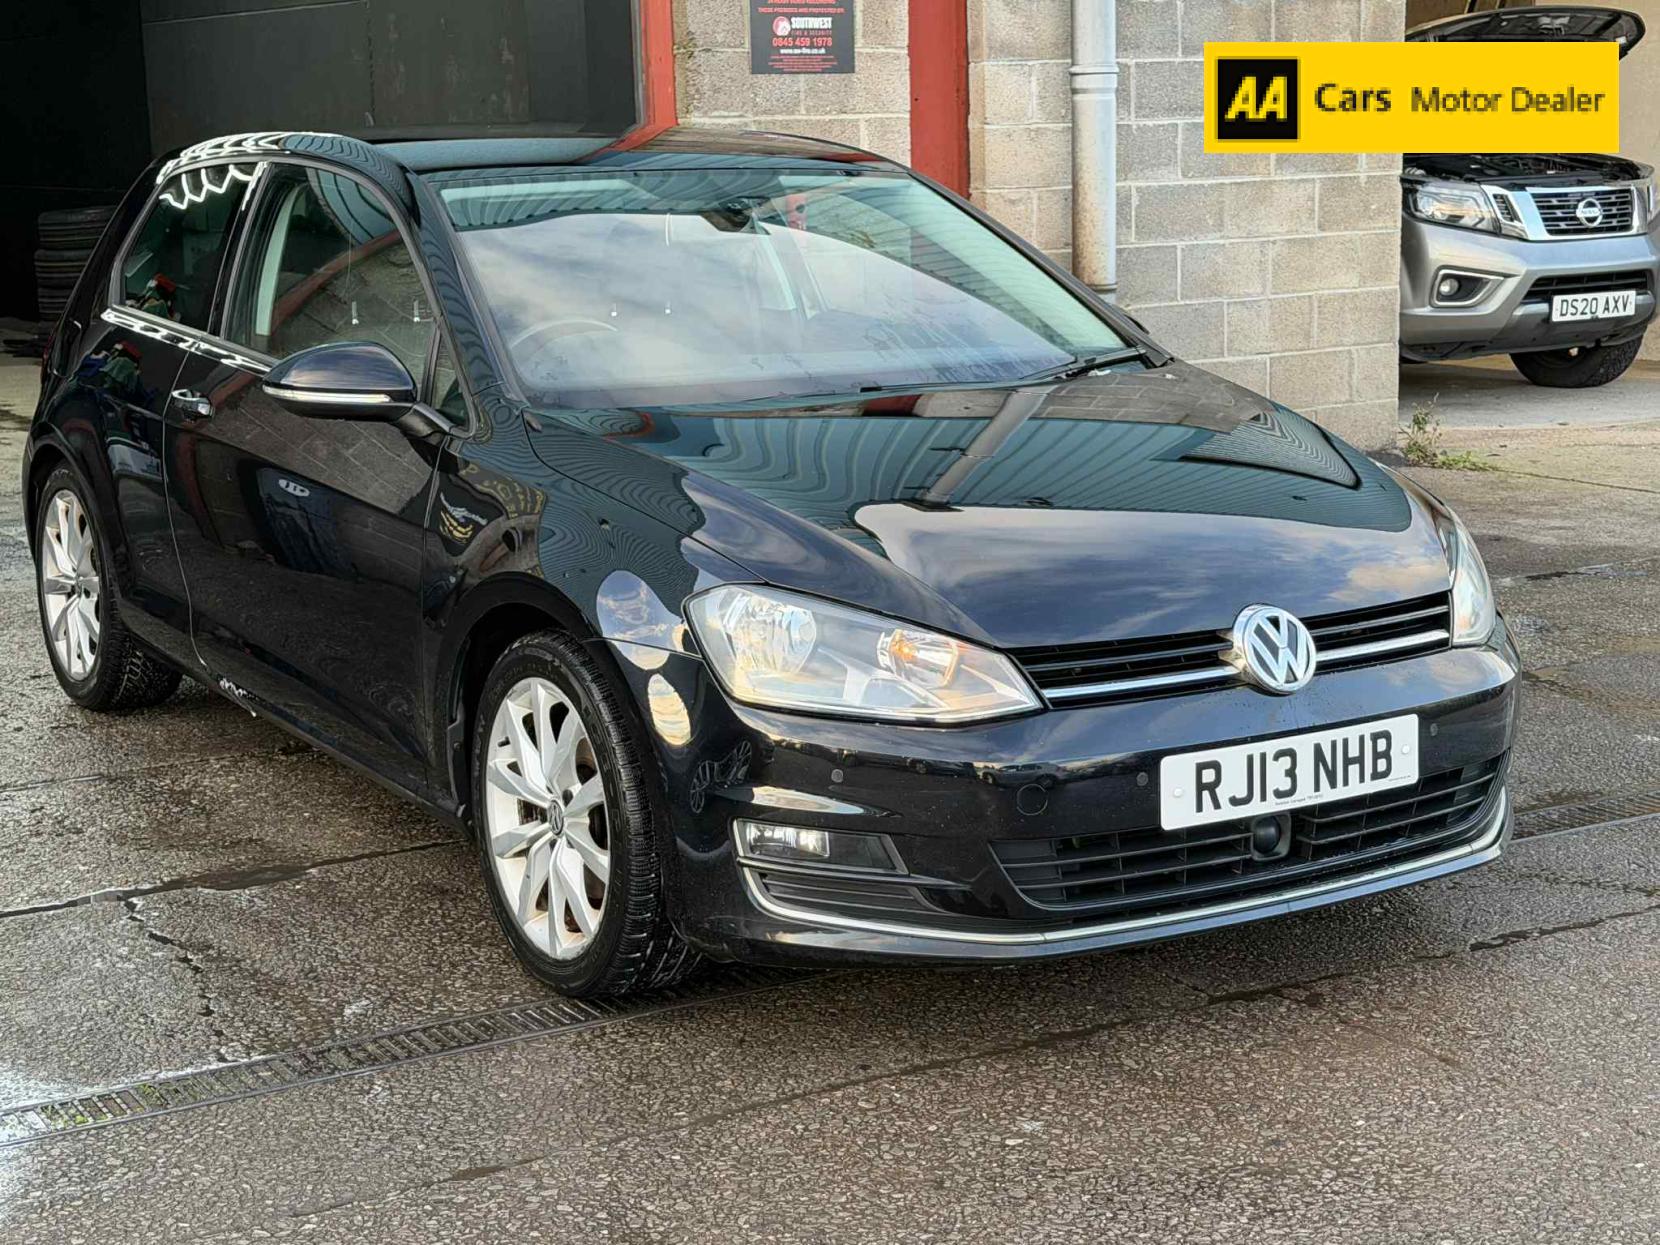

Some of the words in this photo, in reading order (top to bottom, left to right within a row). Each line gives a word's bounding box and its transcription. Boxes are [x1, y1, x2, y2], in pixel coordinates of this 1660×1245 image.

[791, 17, 833, 29] SOUTHWEST
[772, 37, 793, 46] 0845
[795, 37, 811, 46] 459
[813, 37, 833, 46] 1978
[1559, 297, 1599, 317] DS20
[1602, 294, 1630, 315] AXV
[1195, 747, 1298, 813] RJ13
[1313, 729, 1392, 793] NHB
